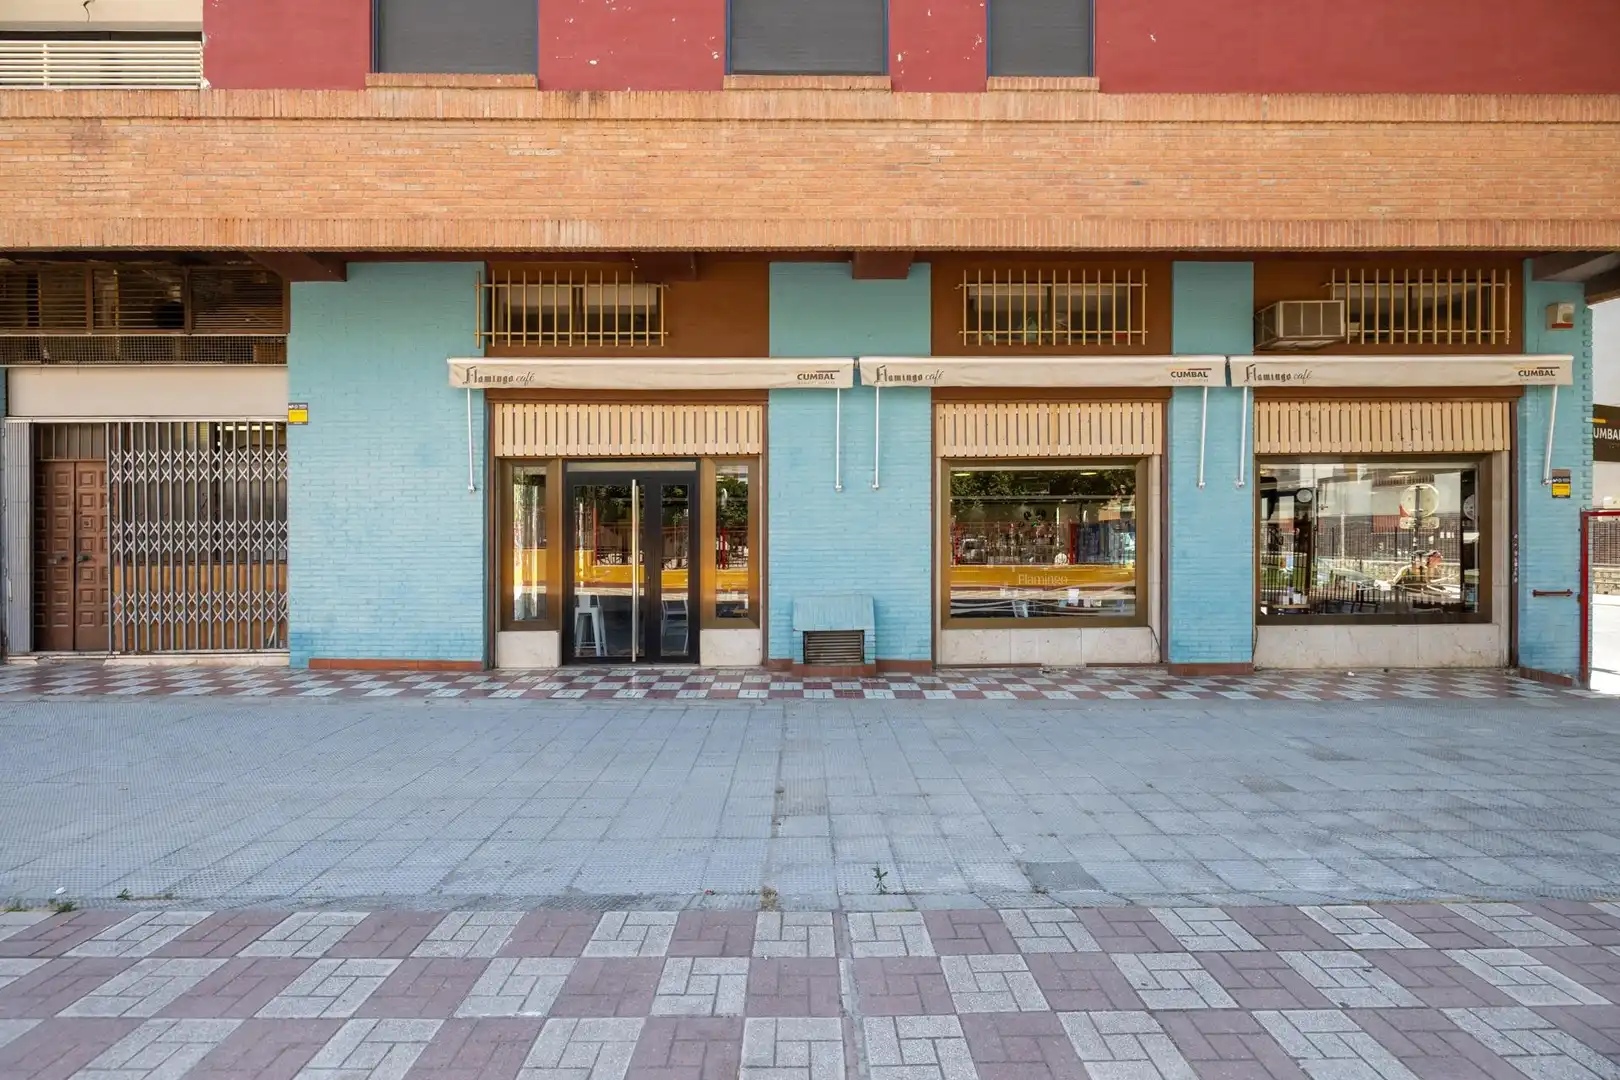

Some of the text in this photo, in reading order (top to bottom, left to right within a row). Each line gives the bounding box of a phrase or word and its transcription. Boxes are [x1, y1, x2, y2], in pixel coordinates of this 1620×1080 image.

[462, 365, 514, 385] Flamingo
[796, 373, 836, 381] CUMBAL
[874, 364, 923, 383] Flamingo
[1244, 363, 1292, 383] Flamingo
[1518, 369, 1556, 377] CUMBAL
[1593, 427, 1620, 441] UMBA
